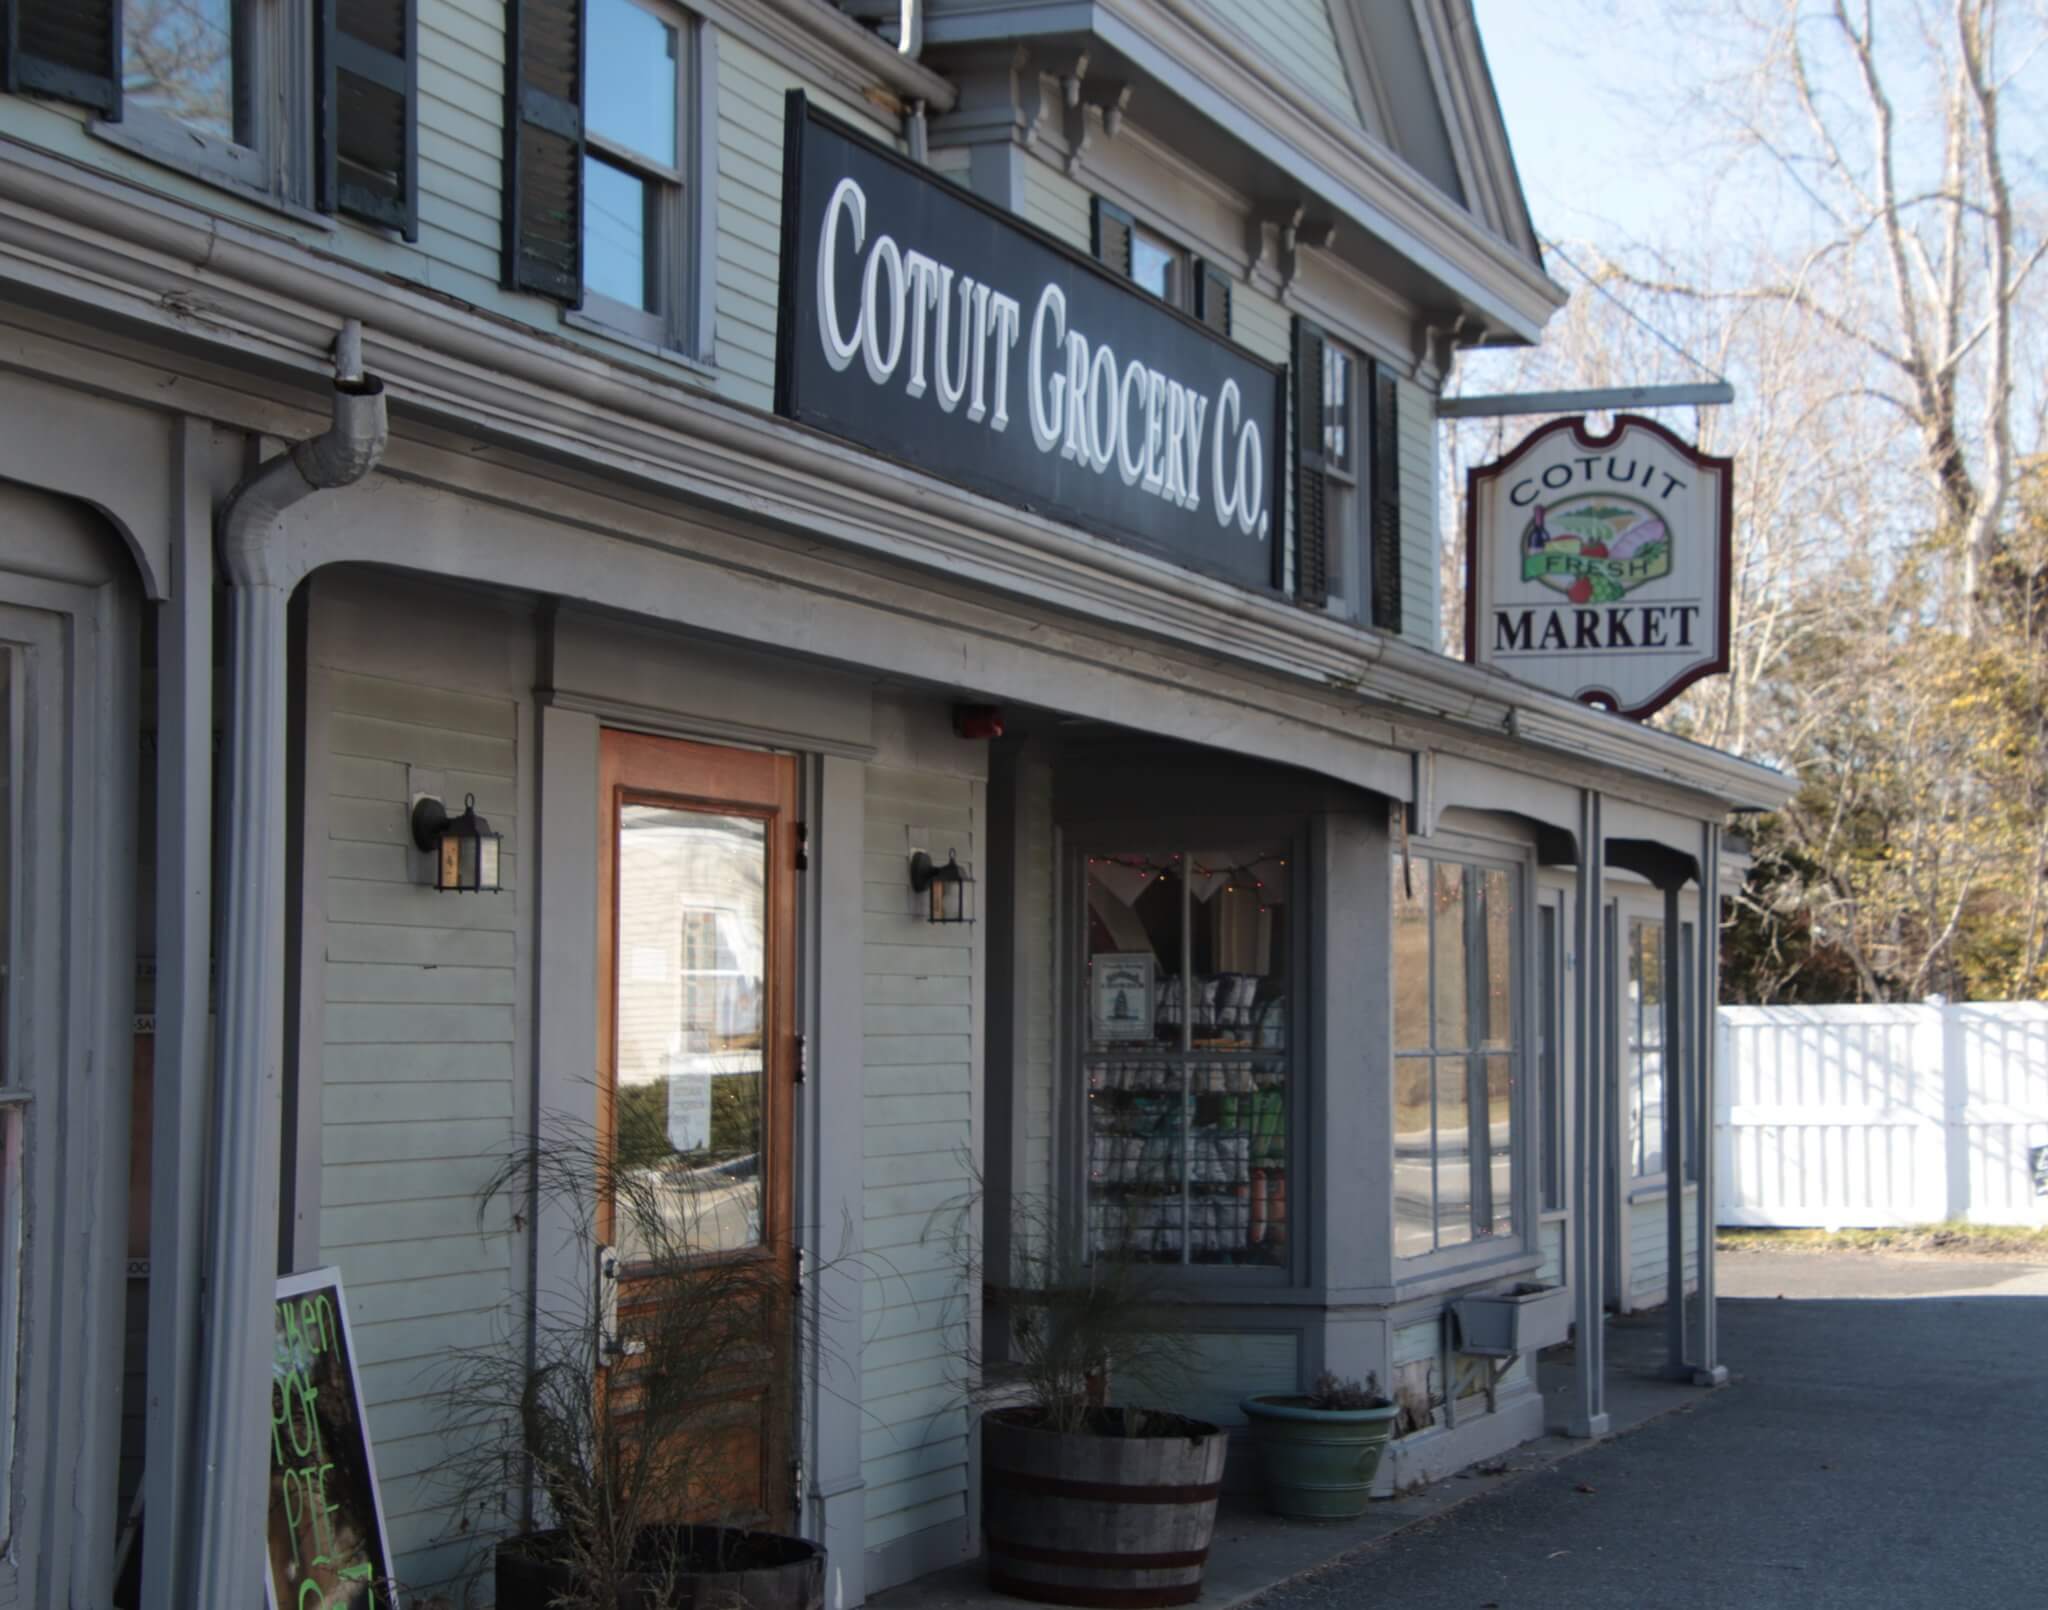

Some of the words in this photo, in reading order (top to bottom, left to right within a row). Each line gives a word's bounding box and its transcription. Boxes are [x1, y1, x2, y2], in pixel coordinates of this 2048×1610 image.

[817, 177, 1020, 433] COTUIT
[1028, 282, 1209, 512] GROCERY
[1509, 456, 1687, 507] COTUIT
[1546, 554, 1648, 577] FRESH
[1493, 605, 1699, 651] MARKET
